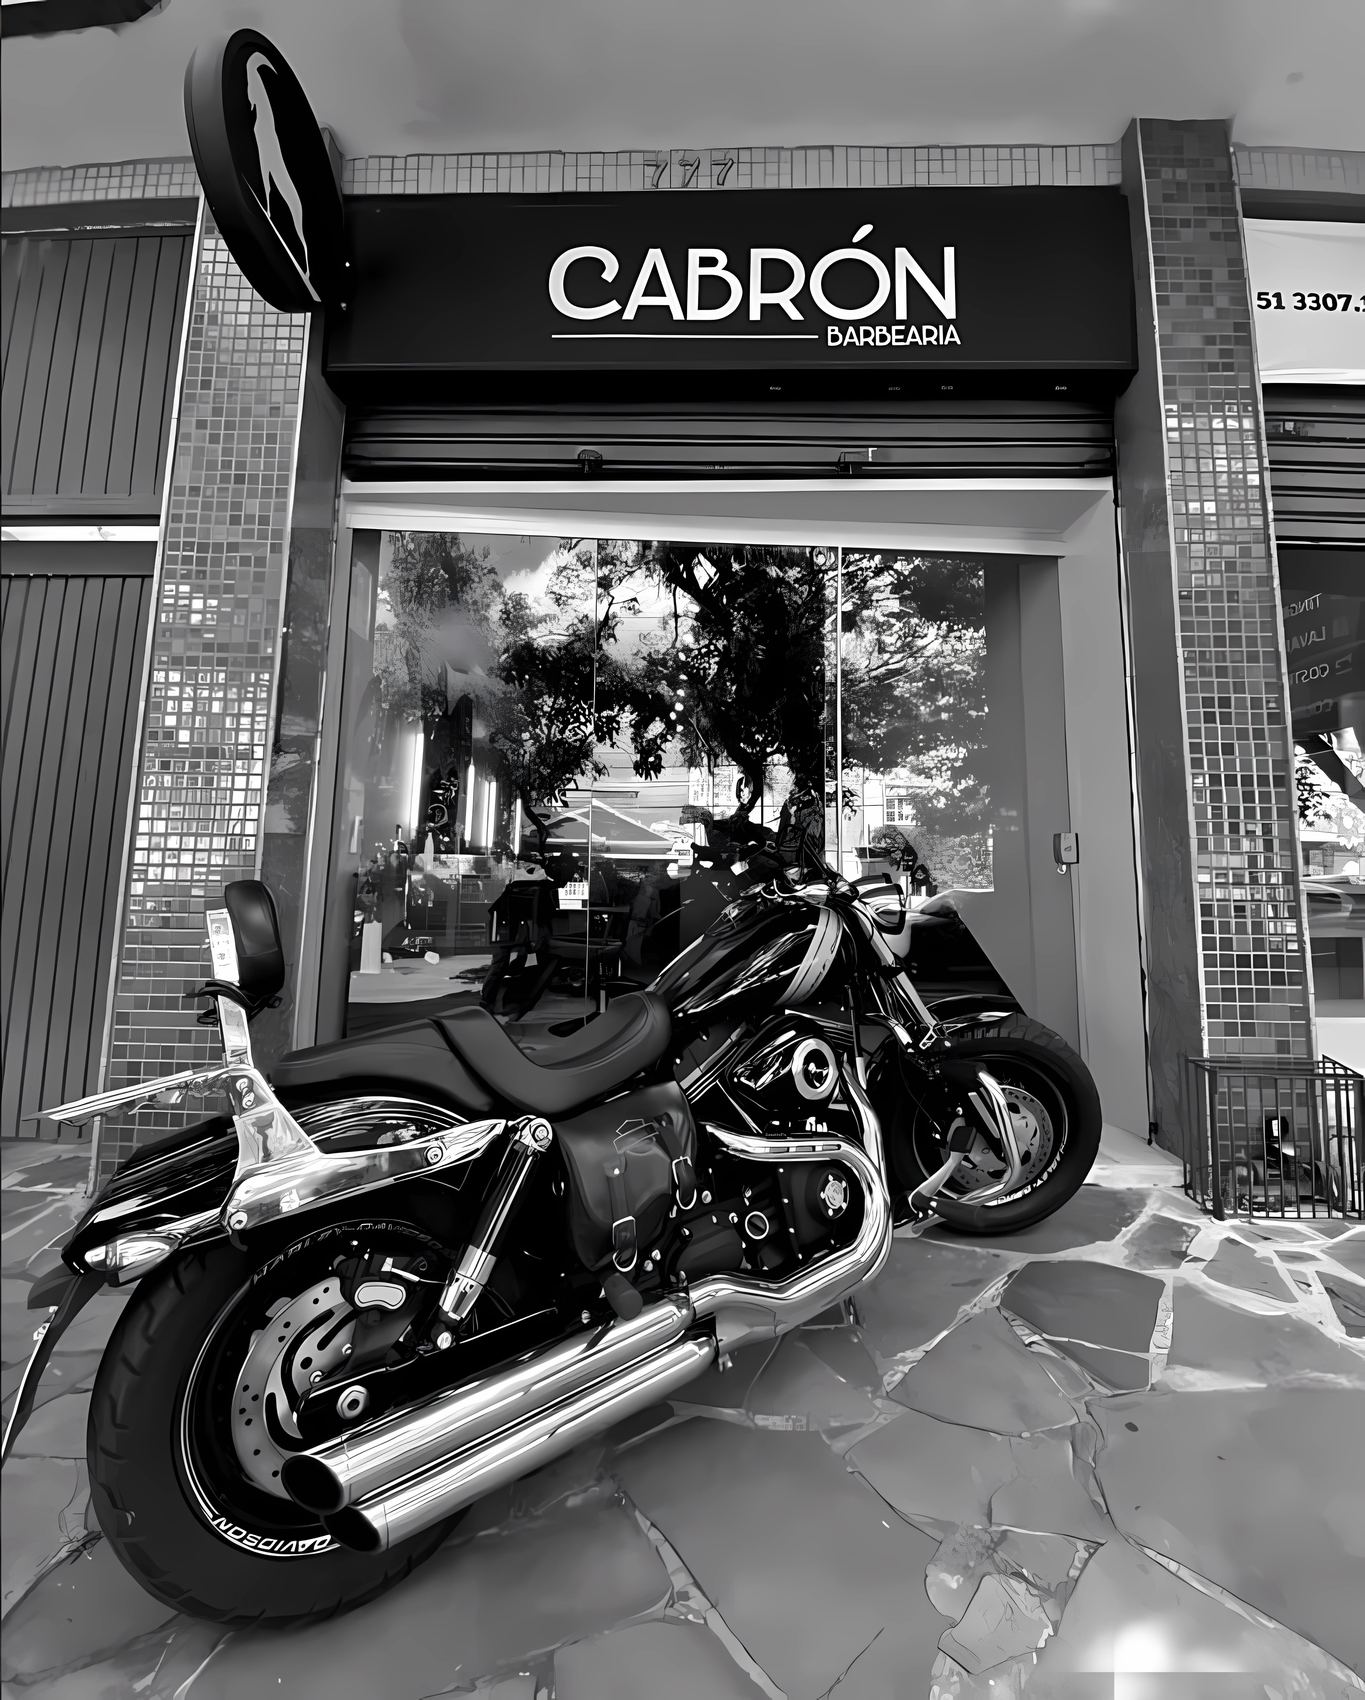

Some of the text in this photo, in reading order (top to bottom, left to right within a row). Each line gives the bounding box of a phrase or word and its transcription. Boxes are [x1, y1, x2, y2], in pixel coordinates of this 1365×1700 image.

[643, 157, 735, 188] 777
[548, 223, 957, 321] CABRÓN
[1256, 292, 1286, 310] 51
[826, 324, 961, 347] BARBEARIA
[213, 1517, 332, 1552] DAVIDSON
